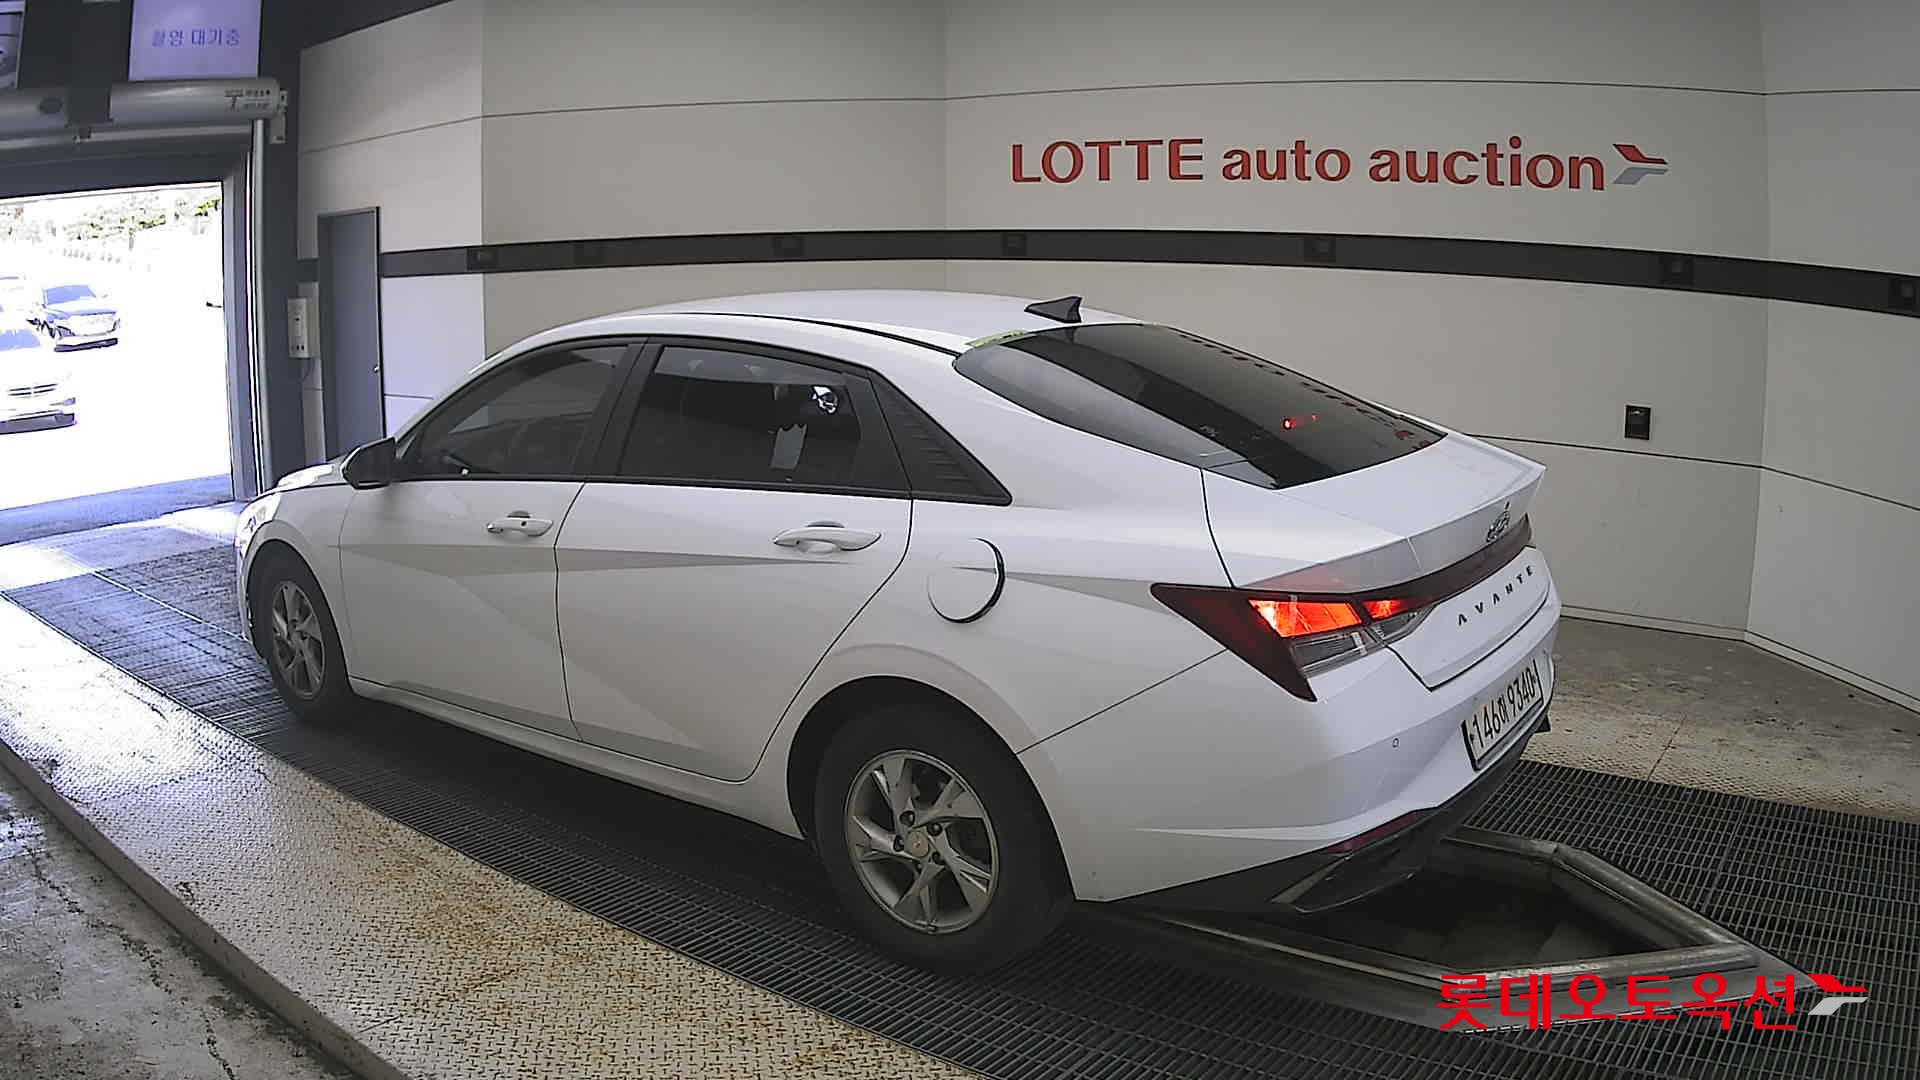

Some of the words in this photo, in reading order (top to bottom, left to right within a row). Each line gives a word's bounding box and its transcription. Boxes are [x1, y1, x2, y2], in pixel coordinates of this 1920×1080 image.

[1011, 138, 1205, 184] LOTTE
[1222, 139, 1351, 182] auto
[1369, 135, 1605, 191] auction
[1458, 564, 1533, 627] AVANTE
